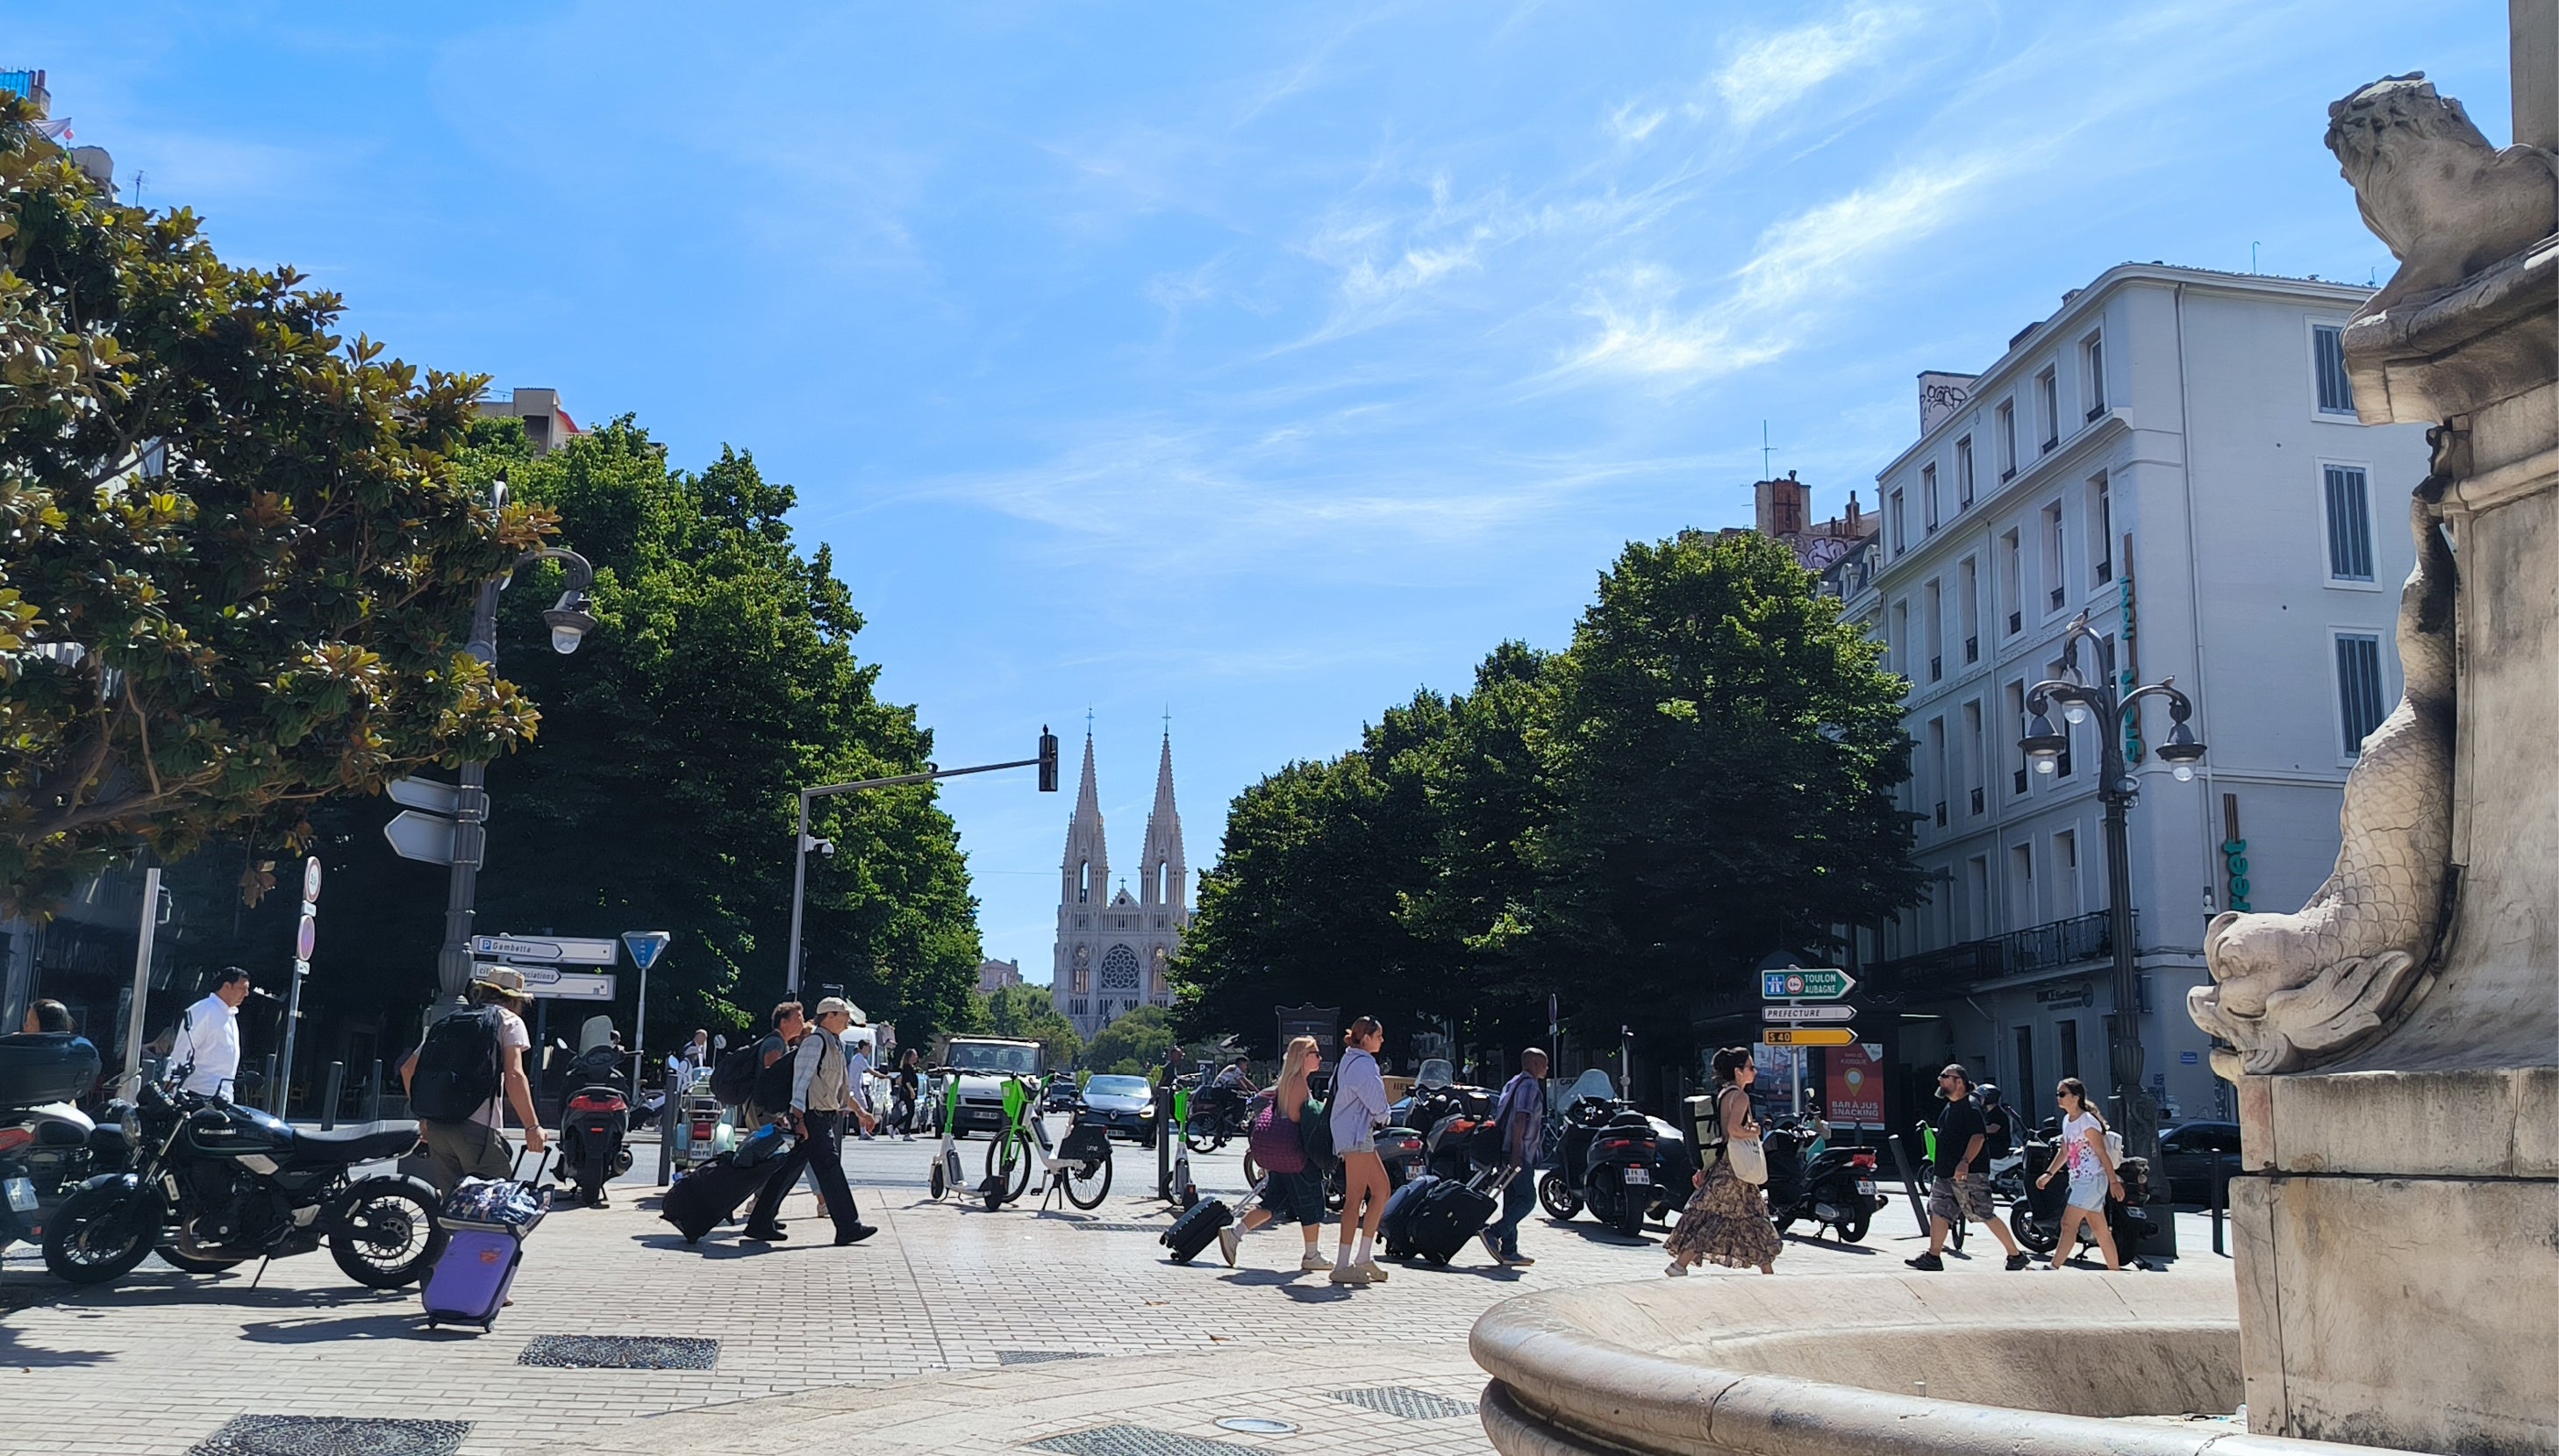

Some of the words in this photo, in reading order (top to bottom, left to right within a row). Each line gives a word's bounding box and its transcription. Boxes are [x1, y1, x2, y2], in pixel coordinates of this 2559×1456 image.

[2119, 575, 2134, 640] hotel
[2222, 839, 2251, 911] reet
[493, 942, 531, 953] Gambetta
[523, 971, 554, 980] ociations
[1805, 985, 1836, 994] AUBAGNE
